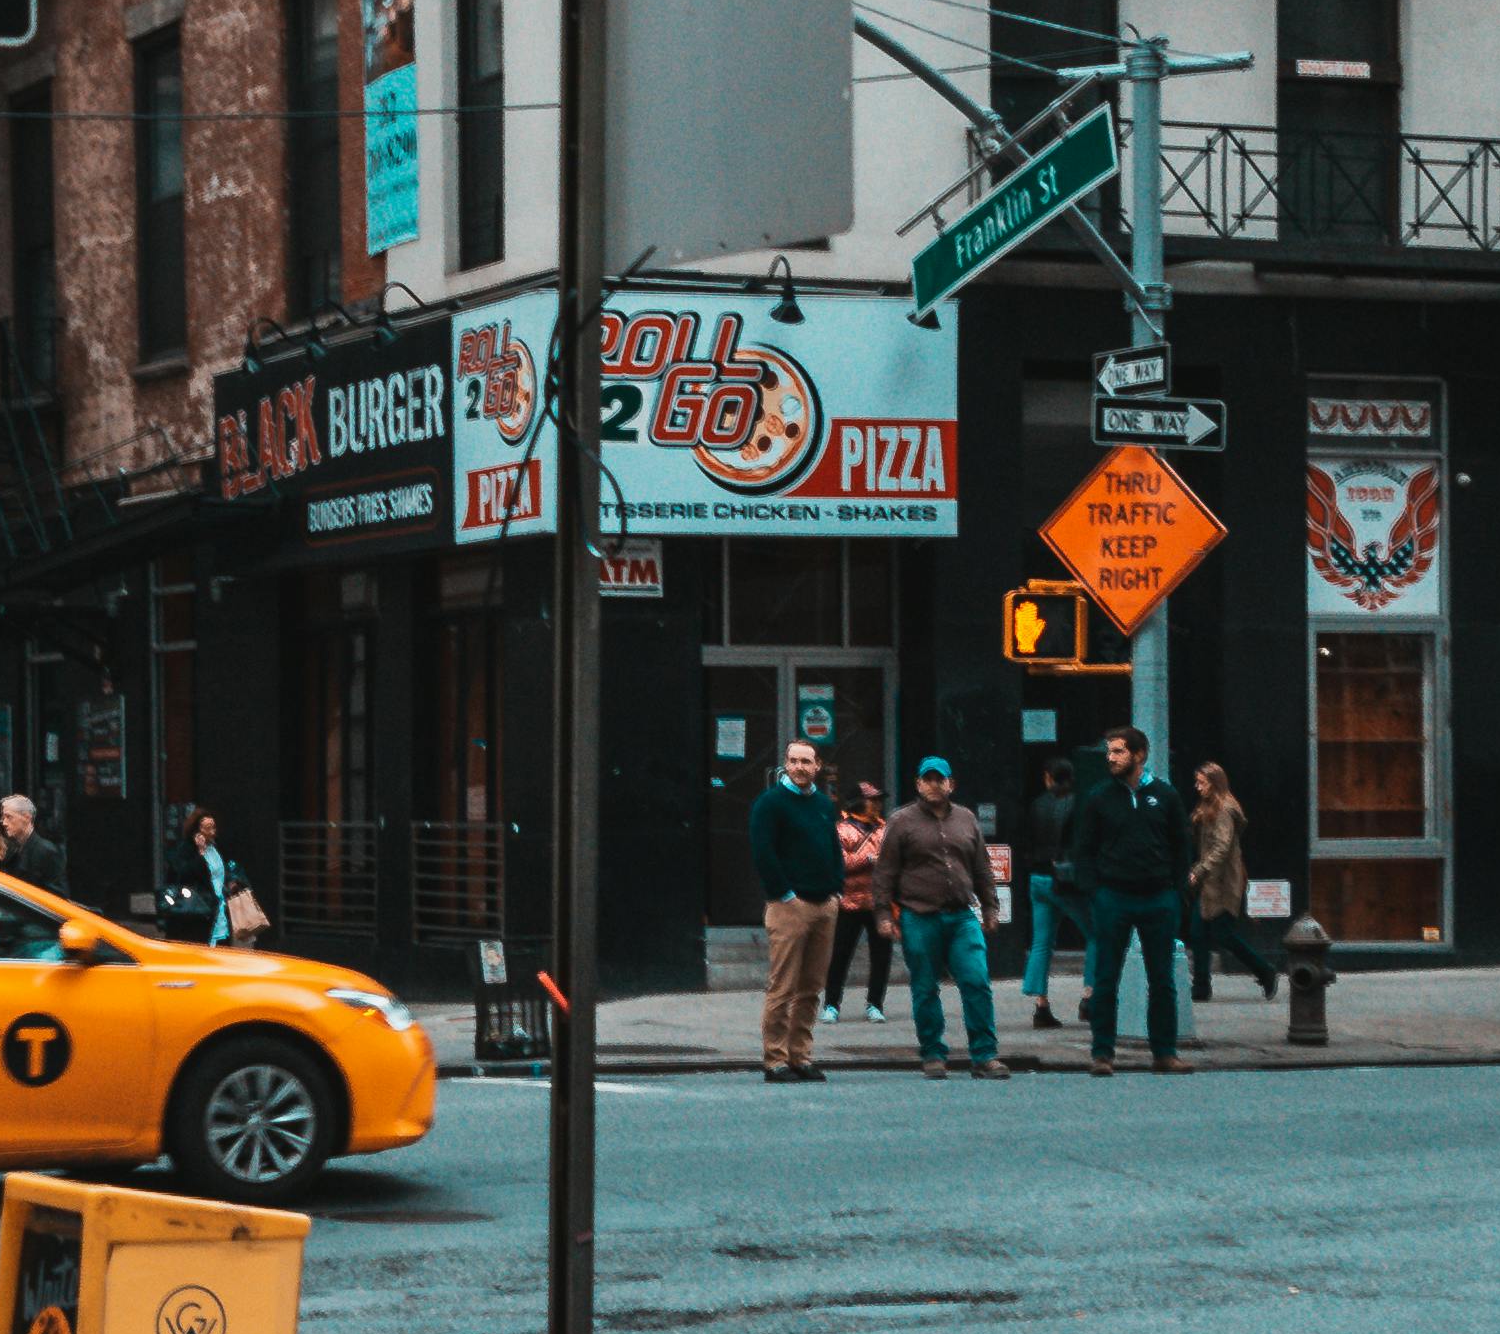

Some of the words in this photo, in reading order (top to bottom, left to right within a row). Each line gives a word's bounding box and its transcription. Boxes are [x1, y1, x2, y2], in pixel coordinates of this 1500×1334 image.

[954, 187, 1033, 268] Franklin
[1036, 162, 1060, 205] St
[457, 319, 520, 381] ROLL
[1135, 362, 1159, 381] WAY
[465, 378, 482, 421] 2
[650, 363, 759, 449] GO
[219, 374, 322, 501] BLACK
[327, 364, 445, 459] BURGER
[1108, 411, 1143, 430] ONE
[1153, 412, 1187, 432] WAY
[840, 425, 946, 493] PIZZA
[478, 468, 533, 525] PIZZA
[1105, 472, 1161, 495] THRU
[713, 503, 821, 521] CHICKEN
[837, 505, 938, 522] SHAKES
[1087, 502, 1177, 526] TRAFFIC
[1102, 535, 1158, 558] KEEP
[1100, 567, 1163, 590] RIGHT
